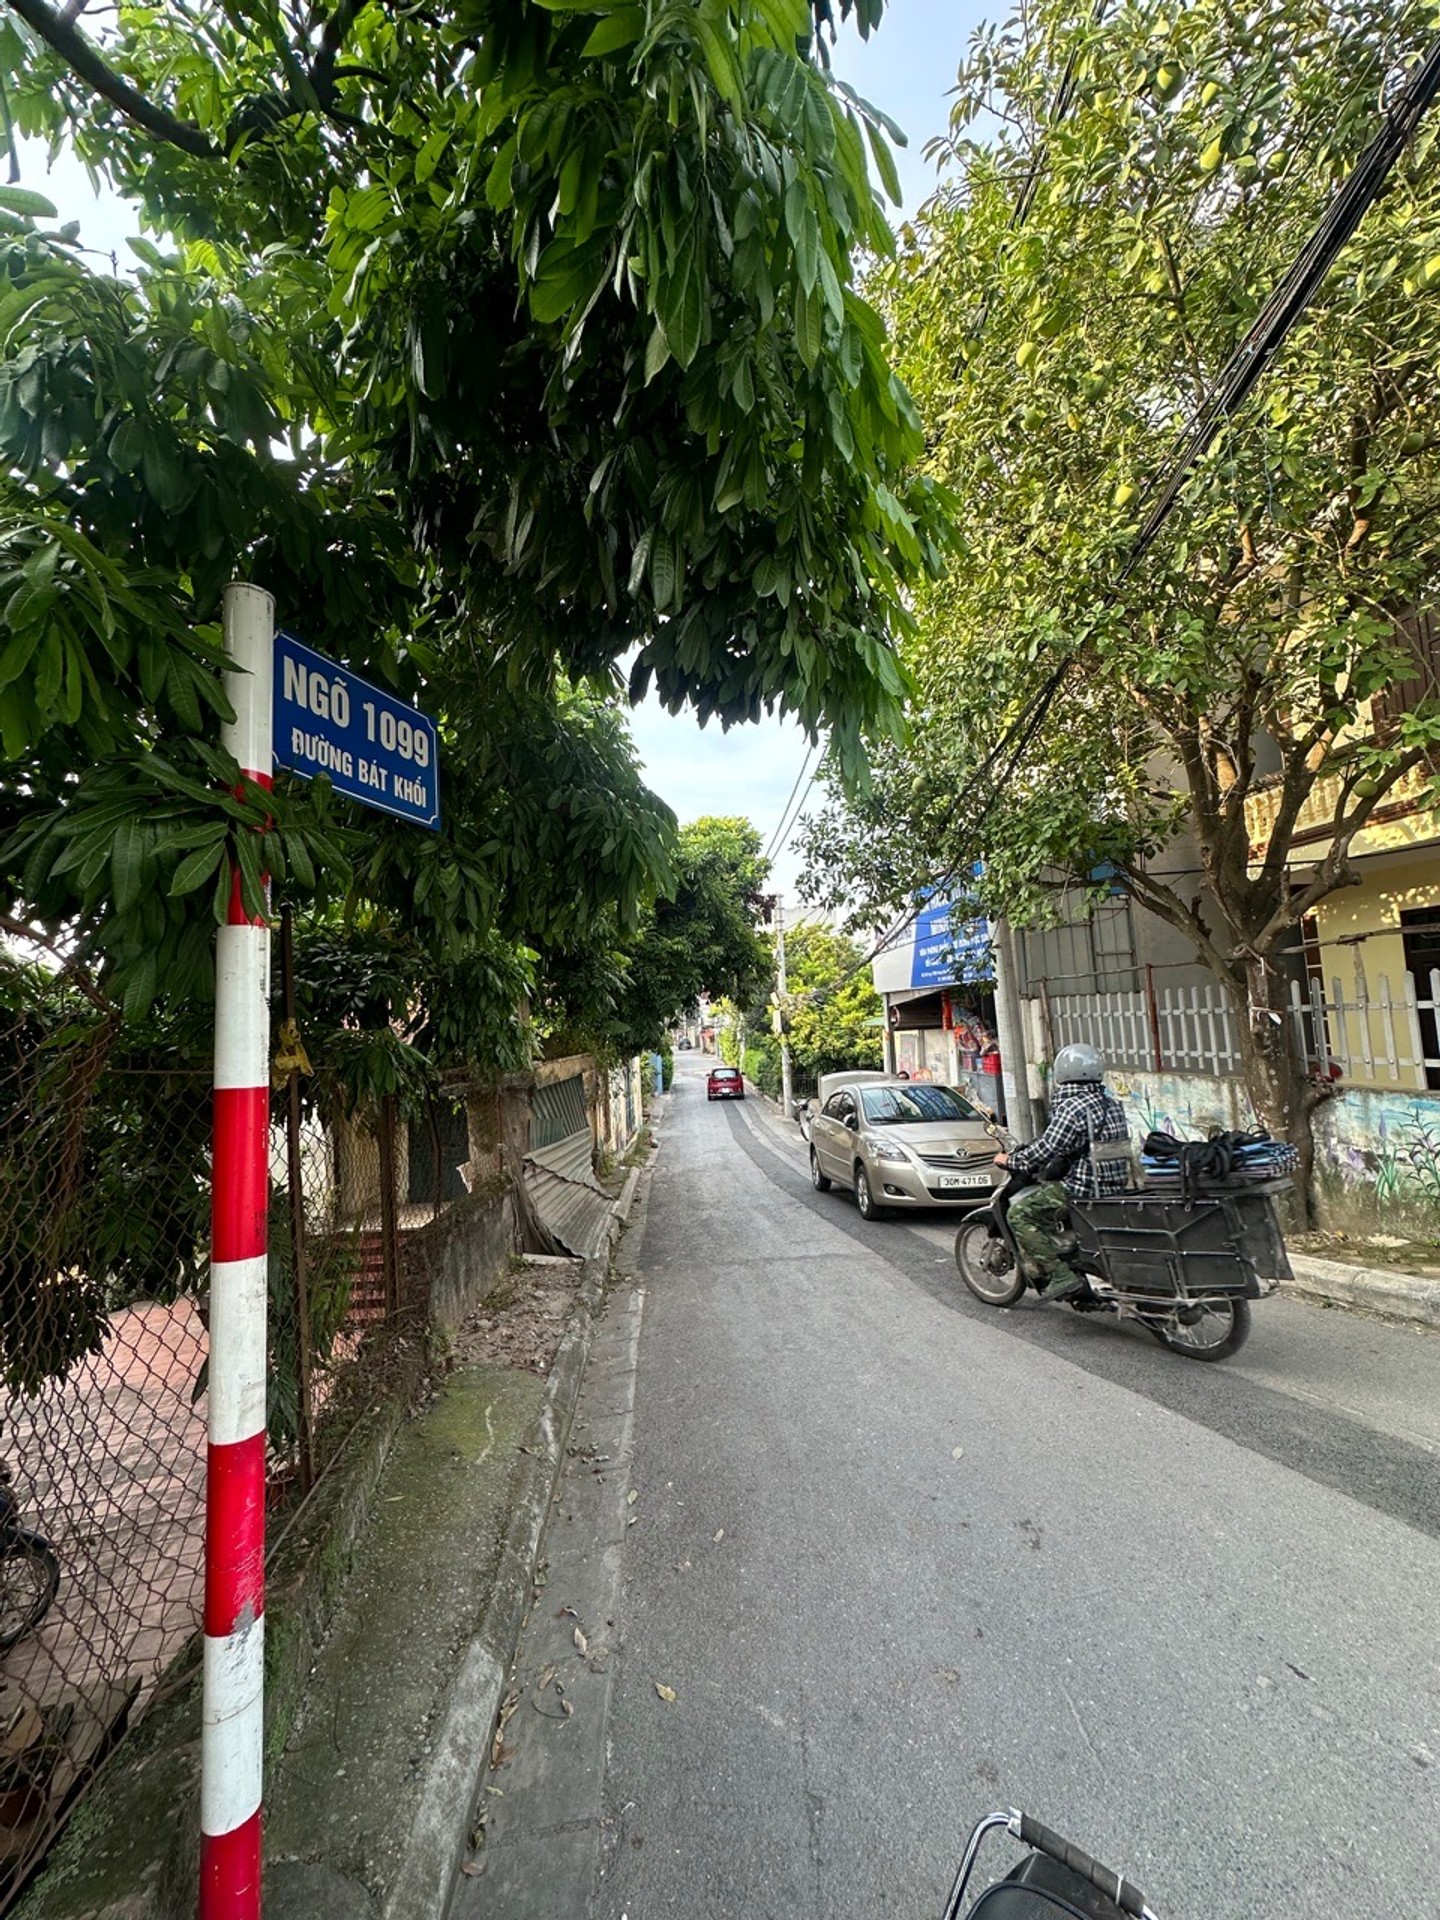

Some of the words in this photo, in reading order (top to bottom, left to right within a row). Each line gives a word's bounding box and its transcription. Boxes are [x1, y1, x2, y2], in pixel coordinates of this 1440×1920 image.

[283, 655, 350, 729] NGÕ
[363, 702, 429, 768] 1099
[291, 727, 353, 778] ĐƯỜNG
[358, 758, 388, 792] BÁT
[394, 774, 427, 808] KHỐI
